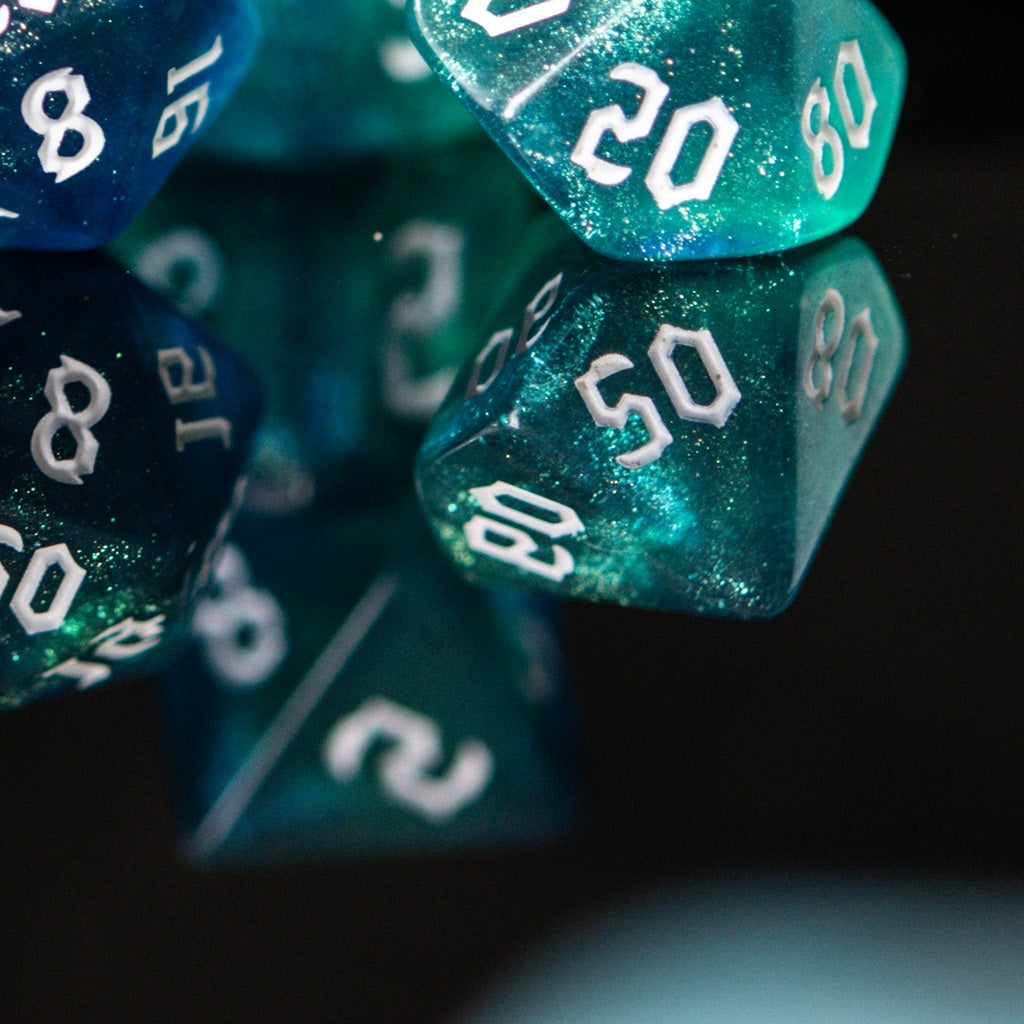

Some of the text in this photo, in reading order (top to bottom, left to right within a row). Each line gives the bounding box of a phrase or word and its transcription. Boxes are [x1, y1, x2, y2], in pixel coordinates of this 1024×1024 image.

[20, 66, 106, 184] 8
[151, 34, 224, 160] 16
[570, 61, 740, 211] 20
[801, 39, 877, 201] 80
